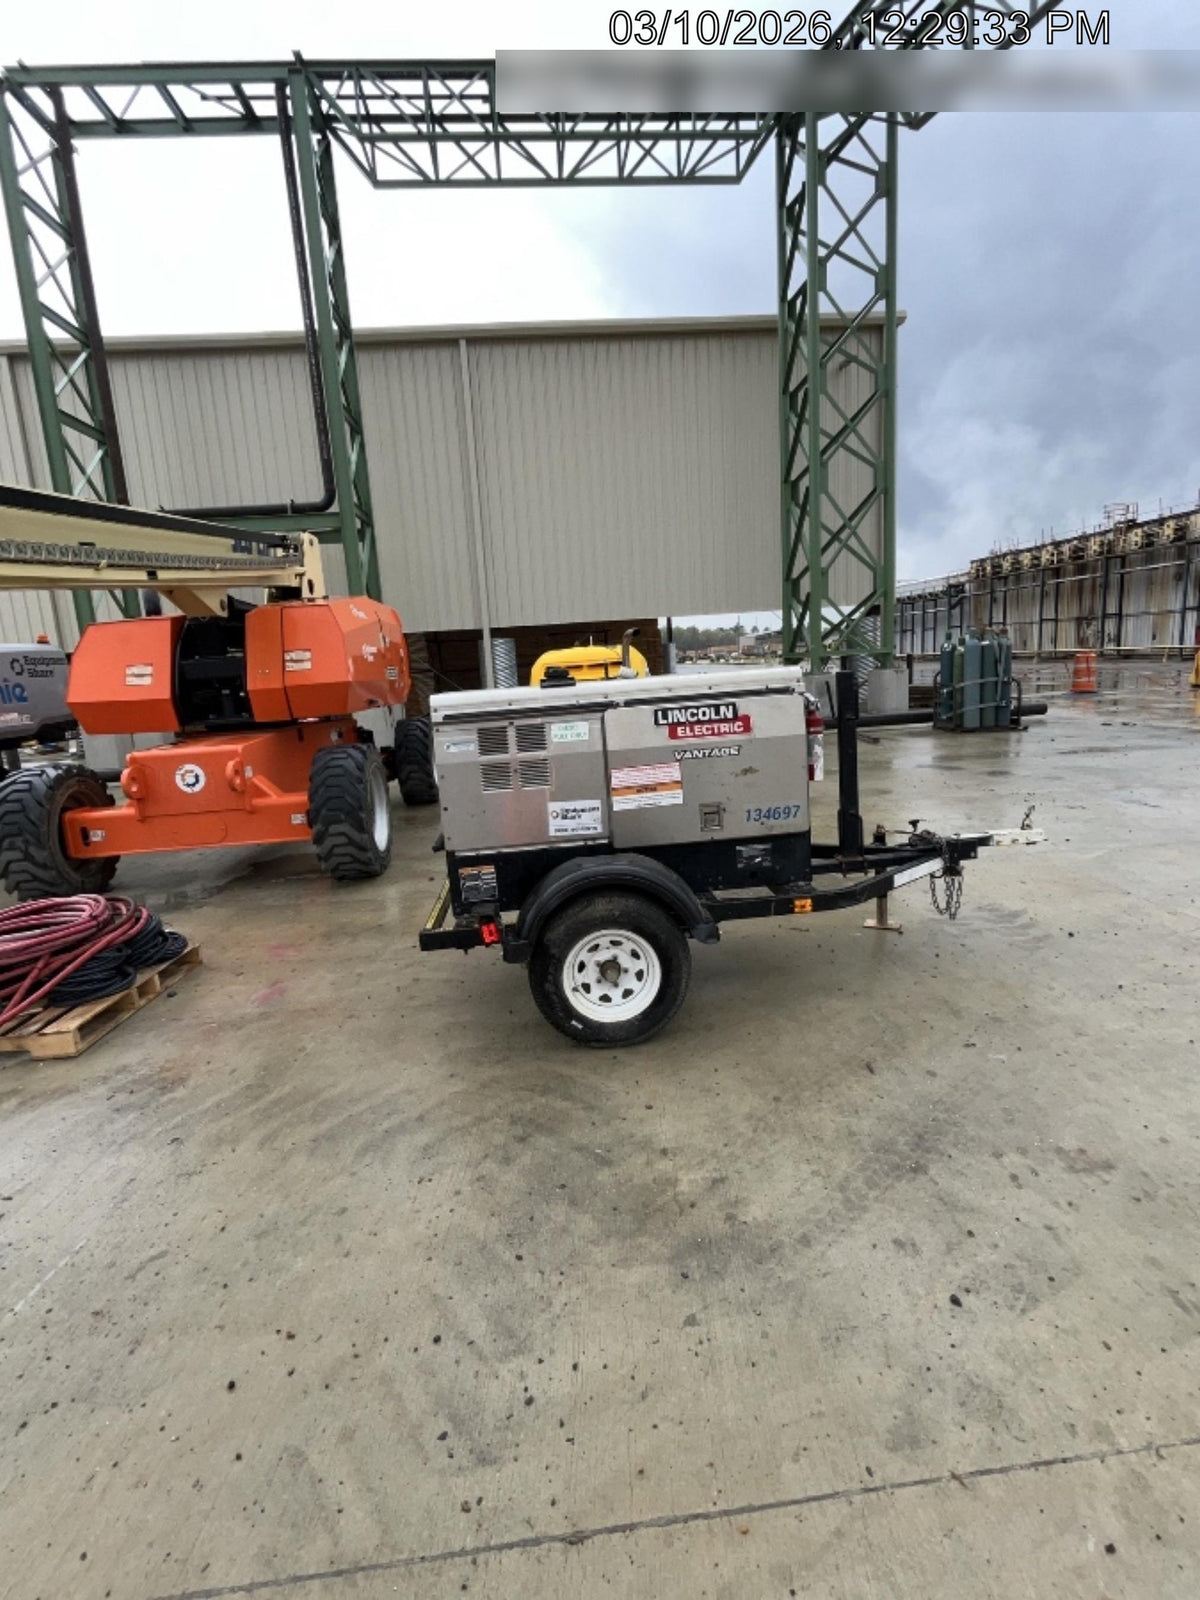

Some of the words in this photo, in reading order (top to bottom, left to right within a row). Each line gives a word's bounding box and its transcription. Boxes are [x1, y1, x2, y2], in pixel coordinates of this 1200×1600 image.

[656, 704, 734, 725] LINCOLN
[676, 721, 745, 737] ELECTRIC
[674, 745, 741, 761] VANTAGE
[745, 804, 801, 823] 134697
